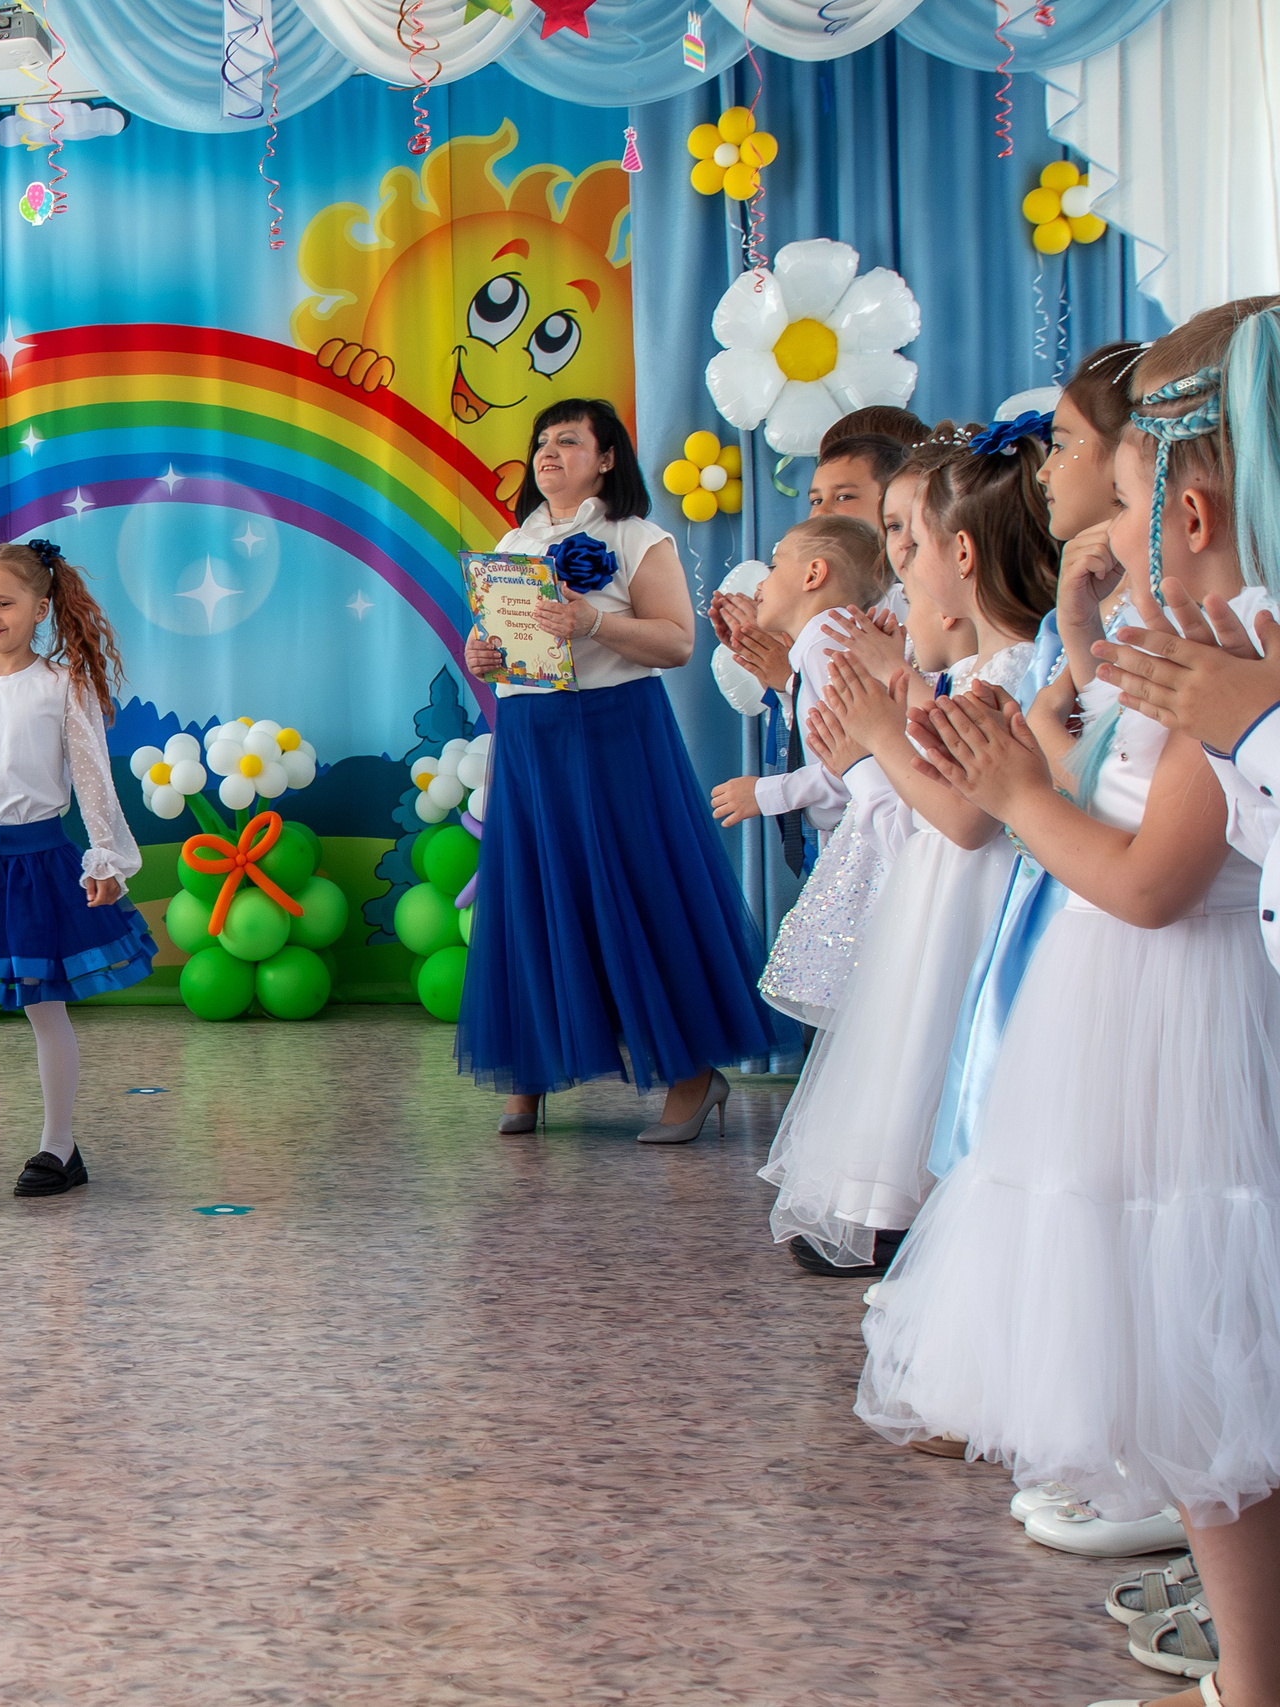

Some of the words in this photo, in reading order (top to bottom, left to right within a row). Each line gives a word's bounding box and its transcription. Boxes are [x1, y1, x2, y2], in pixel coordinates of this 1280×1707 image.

[474, 566, 487, 579] До
[526, 578, 544, 587] сад
[501, 595, 531, 606] Группа
[505, 619, 539, 631] Выпуск
[513, 632, 533, 641] 2026
